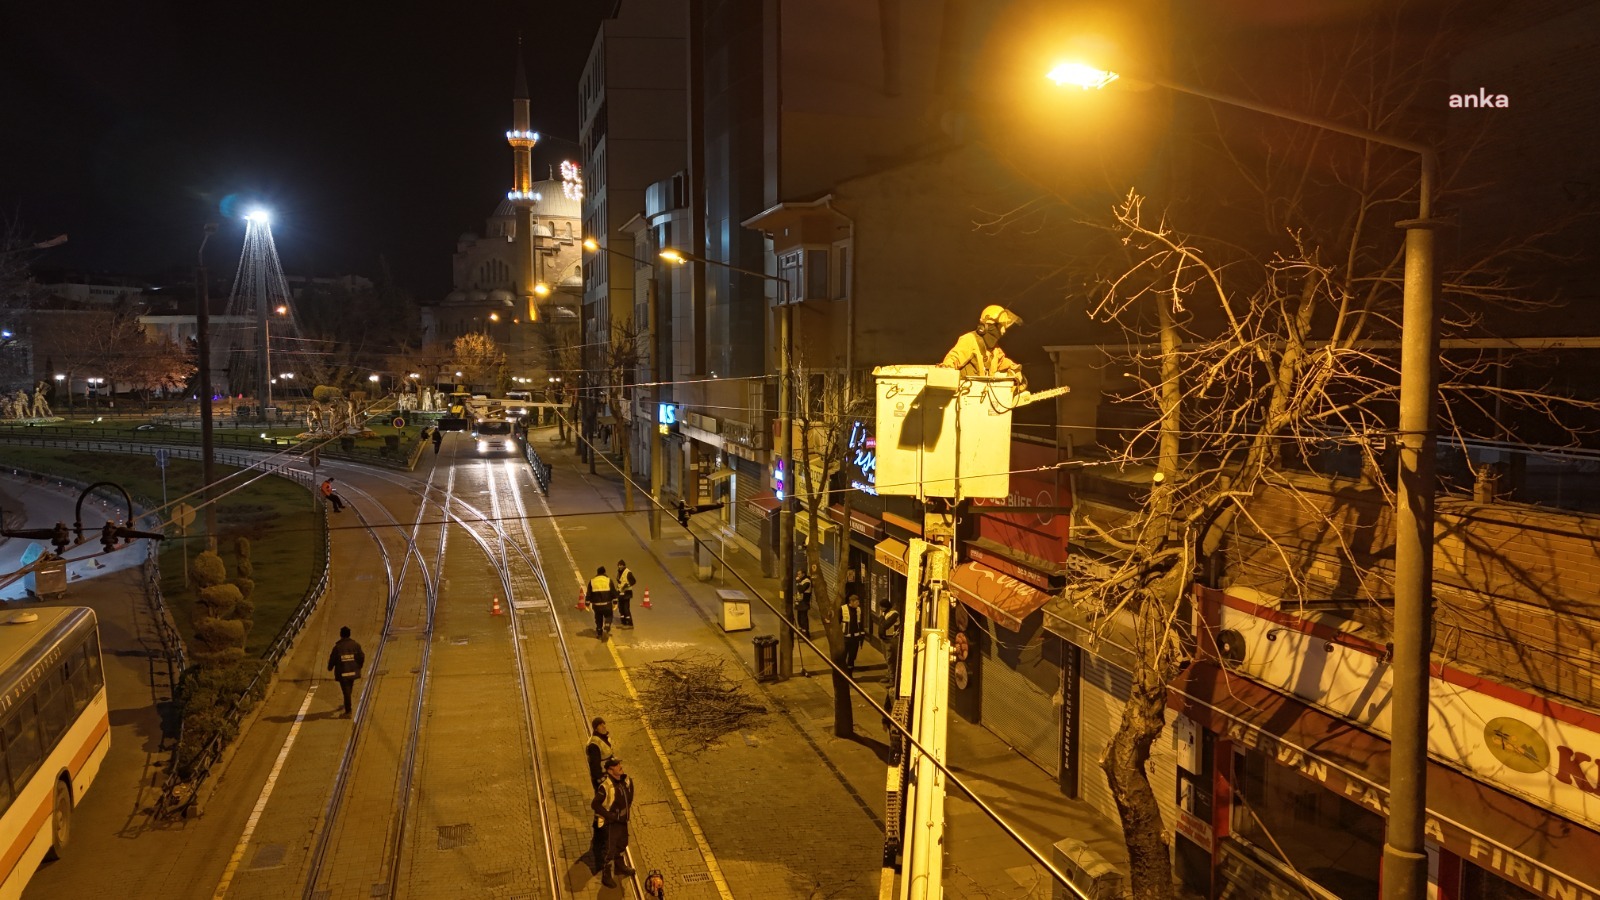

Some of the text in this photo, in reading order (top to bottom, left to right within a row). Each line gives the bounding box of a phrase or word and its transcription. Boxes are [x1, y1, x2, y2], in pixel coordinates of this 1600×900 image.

[1226, 719, 1327, 782] KERVAN
[1344, 778, 1445, 843] PAA
[1555, 745, 1600, 797] K
